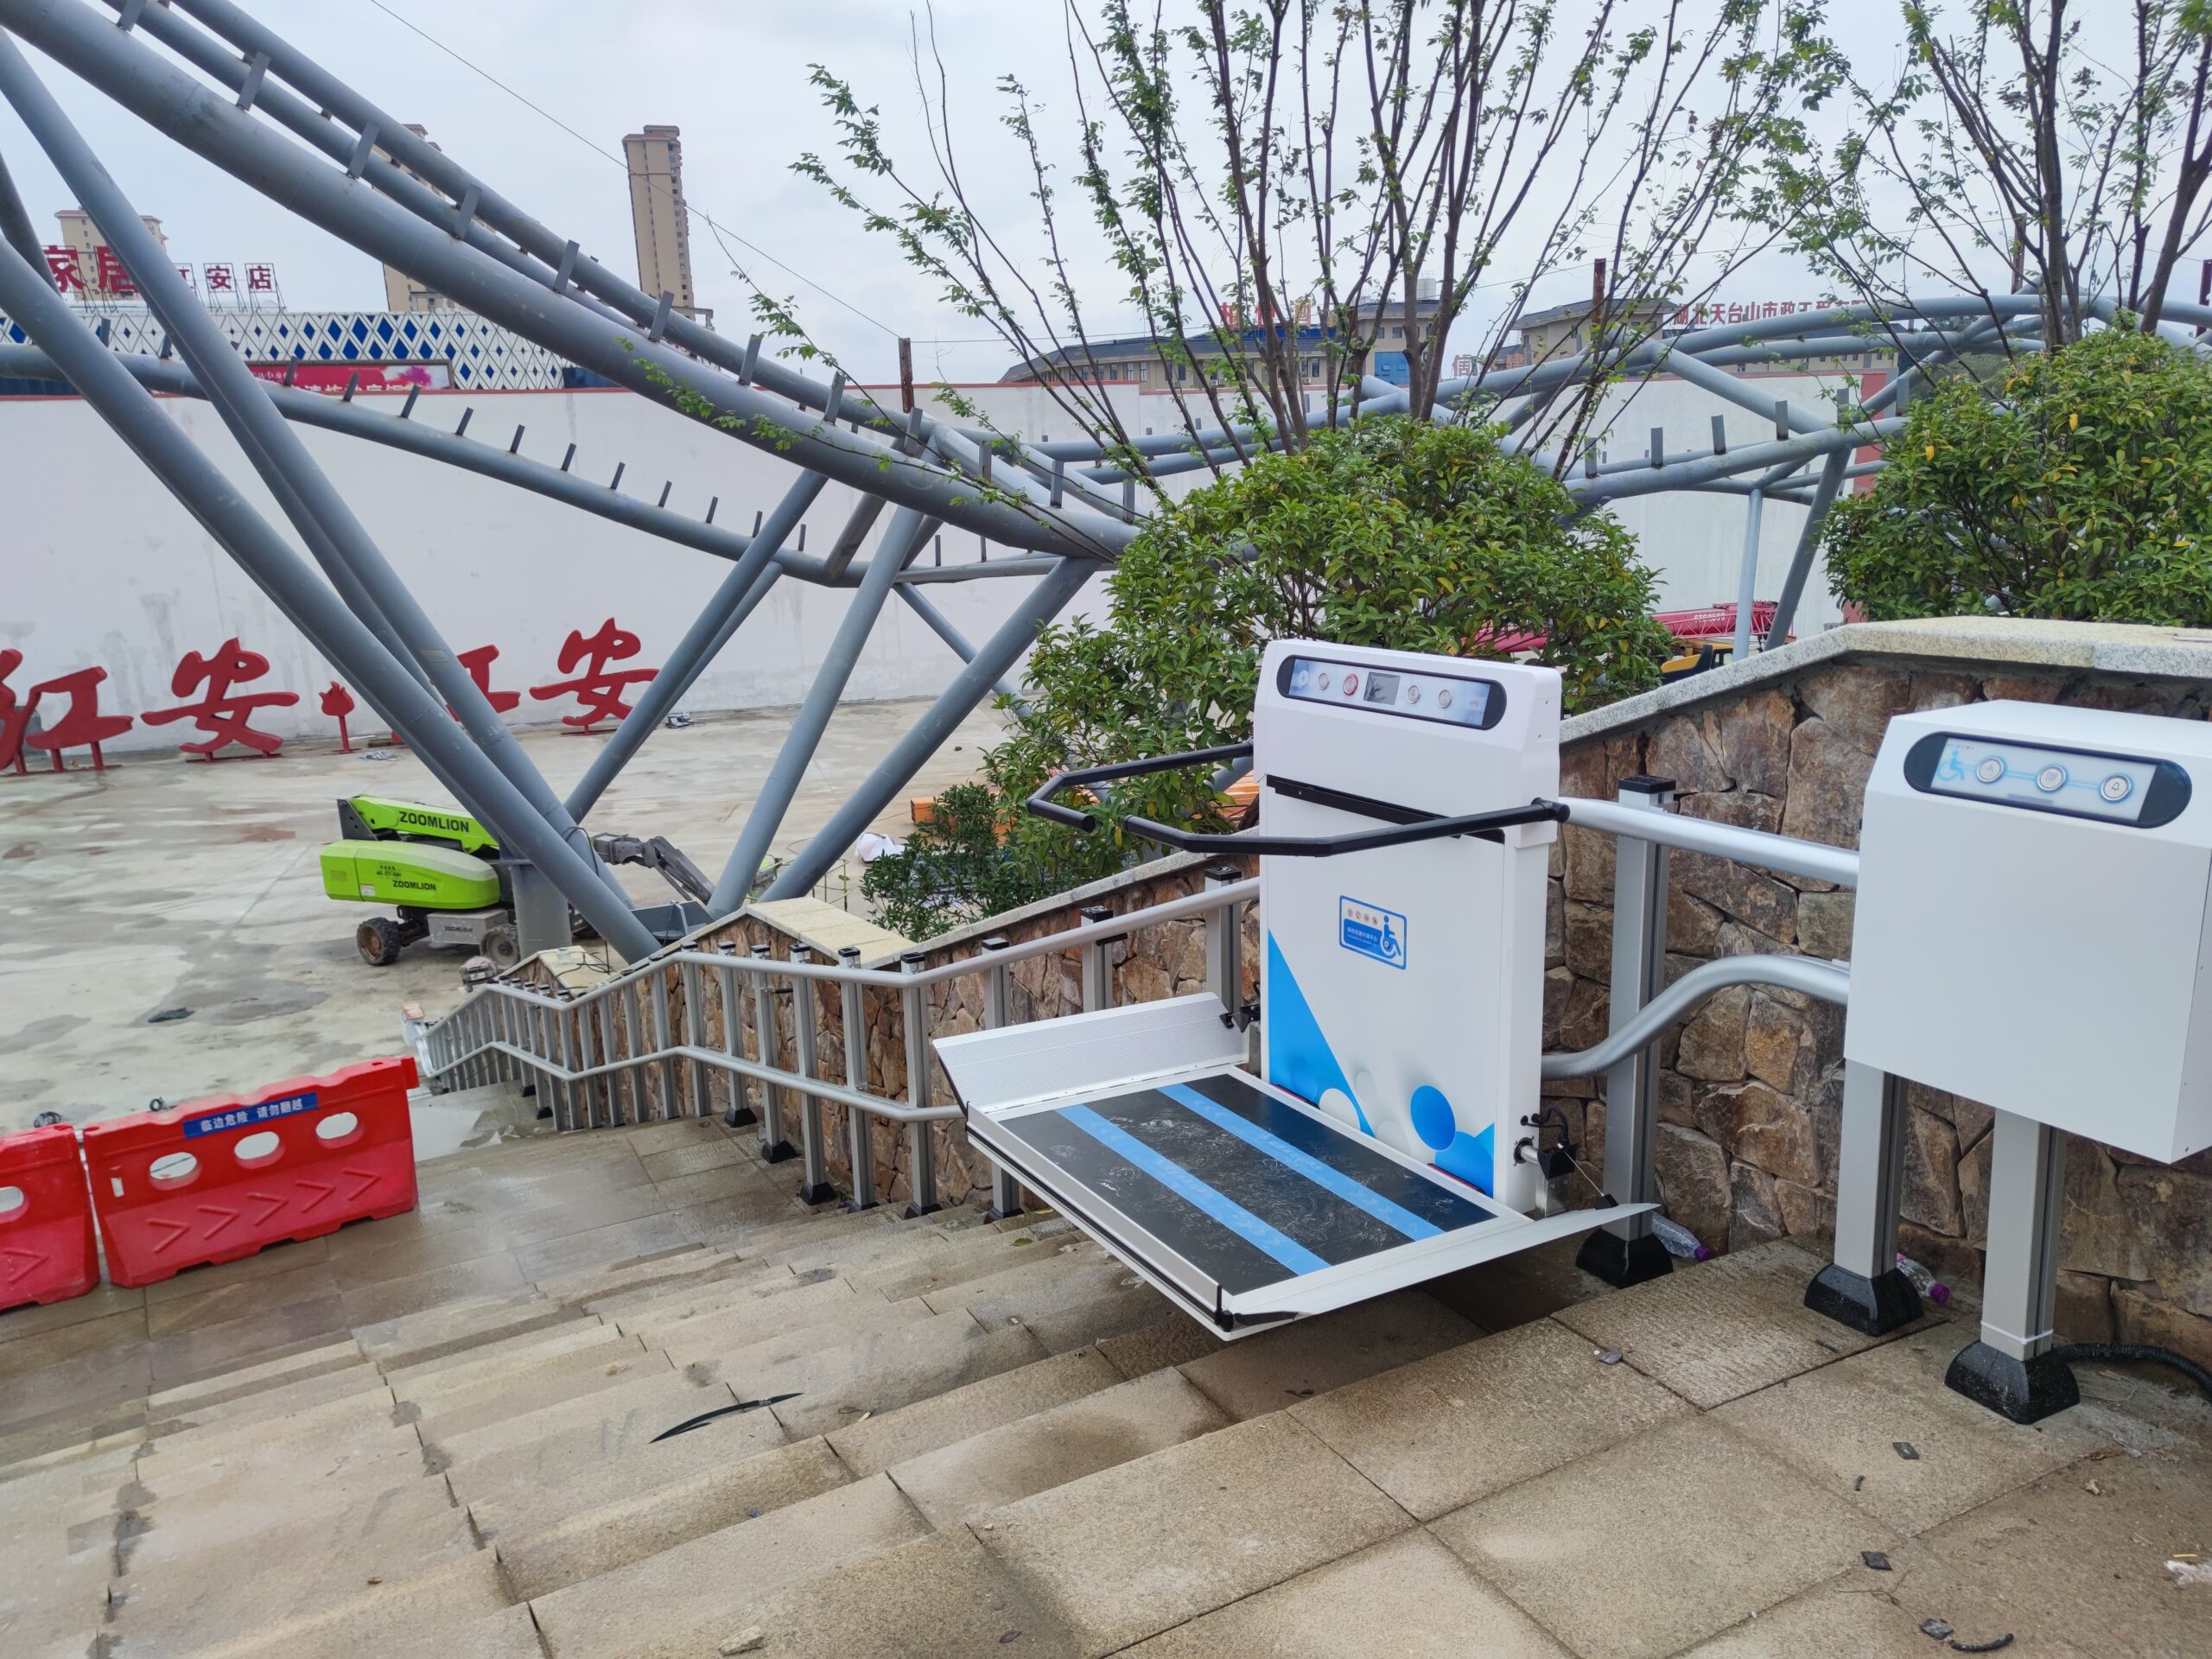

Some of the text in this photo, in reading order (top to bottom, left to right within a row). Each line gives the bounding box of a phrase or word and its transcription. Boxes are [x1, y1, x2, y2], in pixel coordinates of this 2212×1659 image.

[177, 265, 271, 290] 安店
[399, 811, 469, 833] ZOOMLION
[392, 880, 436, 891] ZOOMLION
